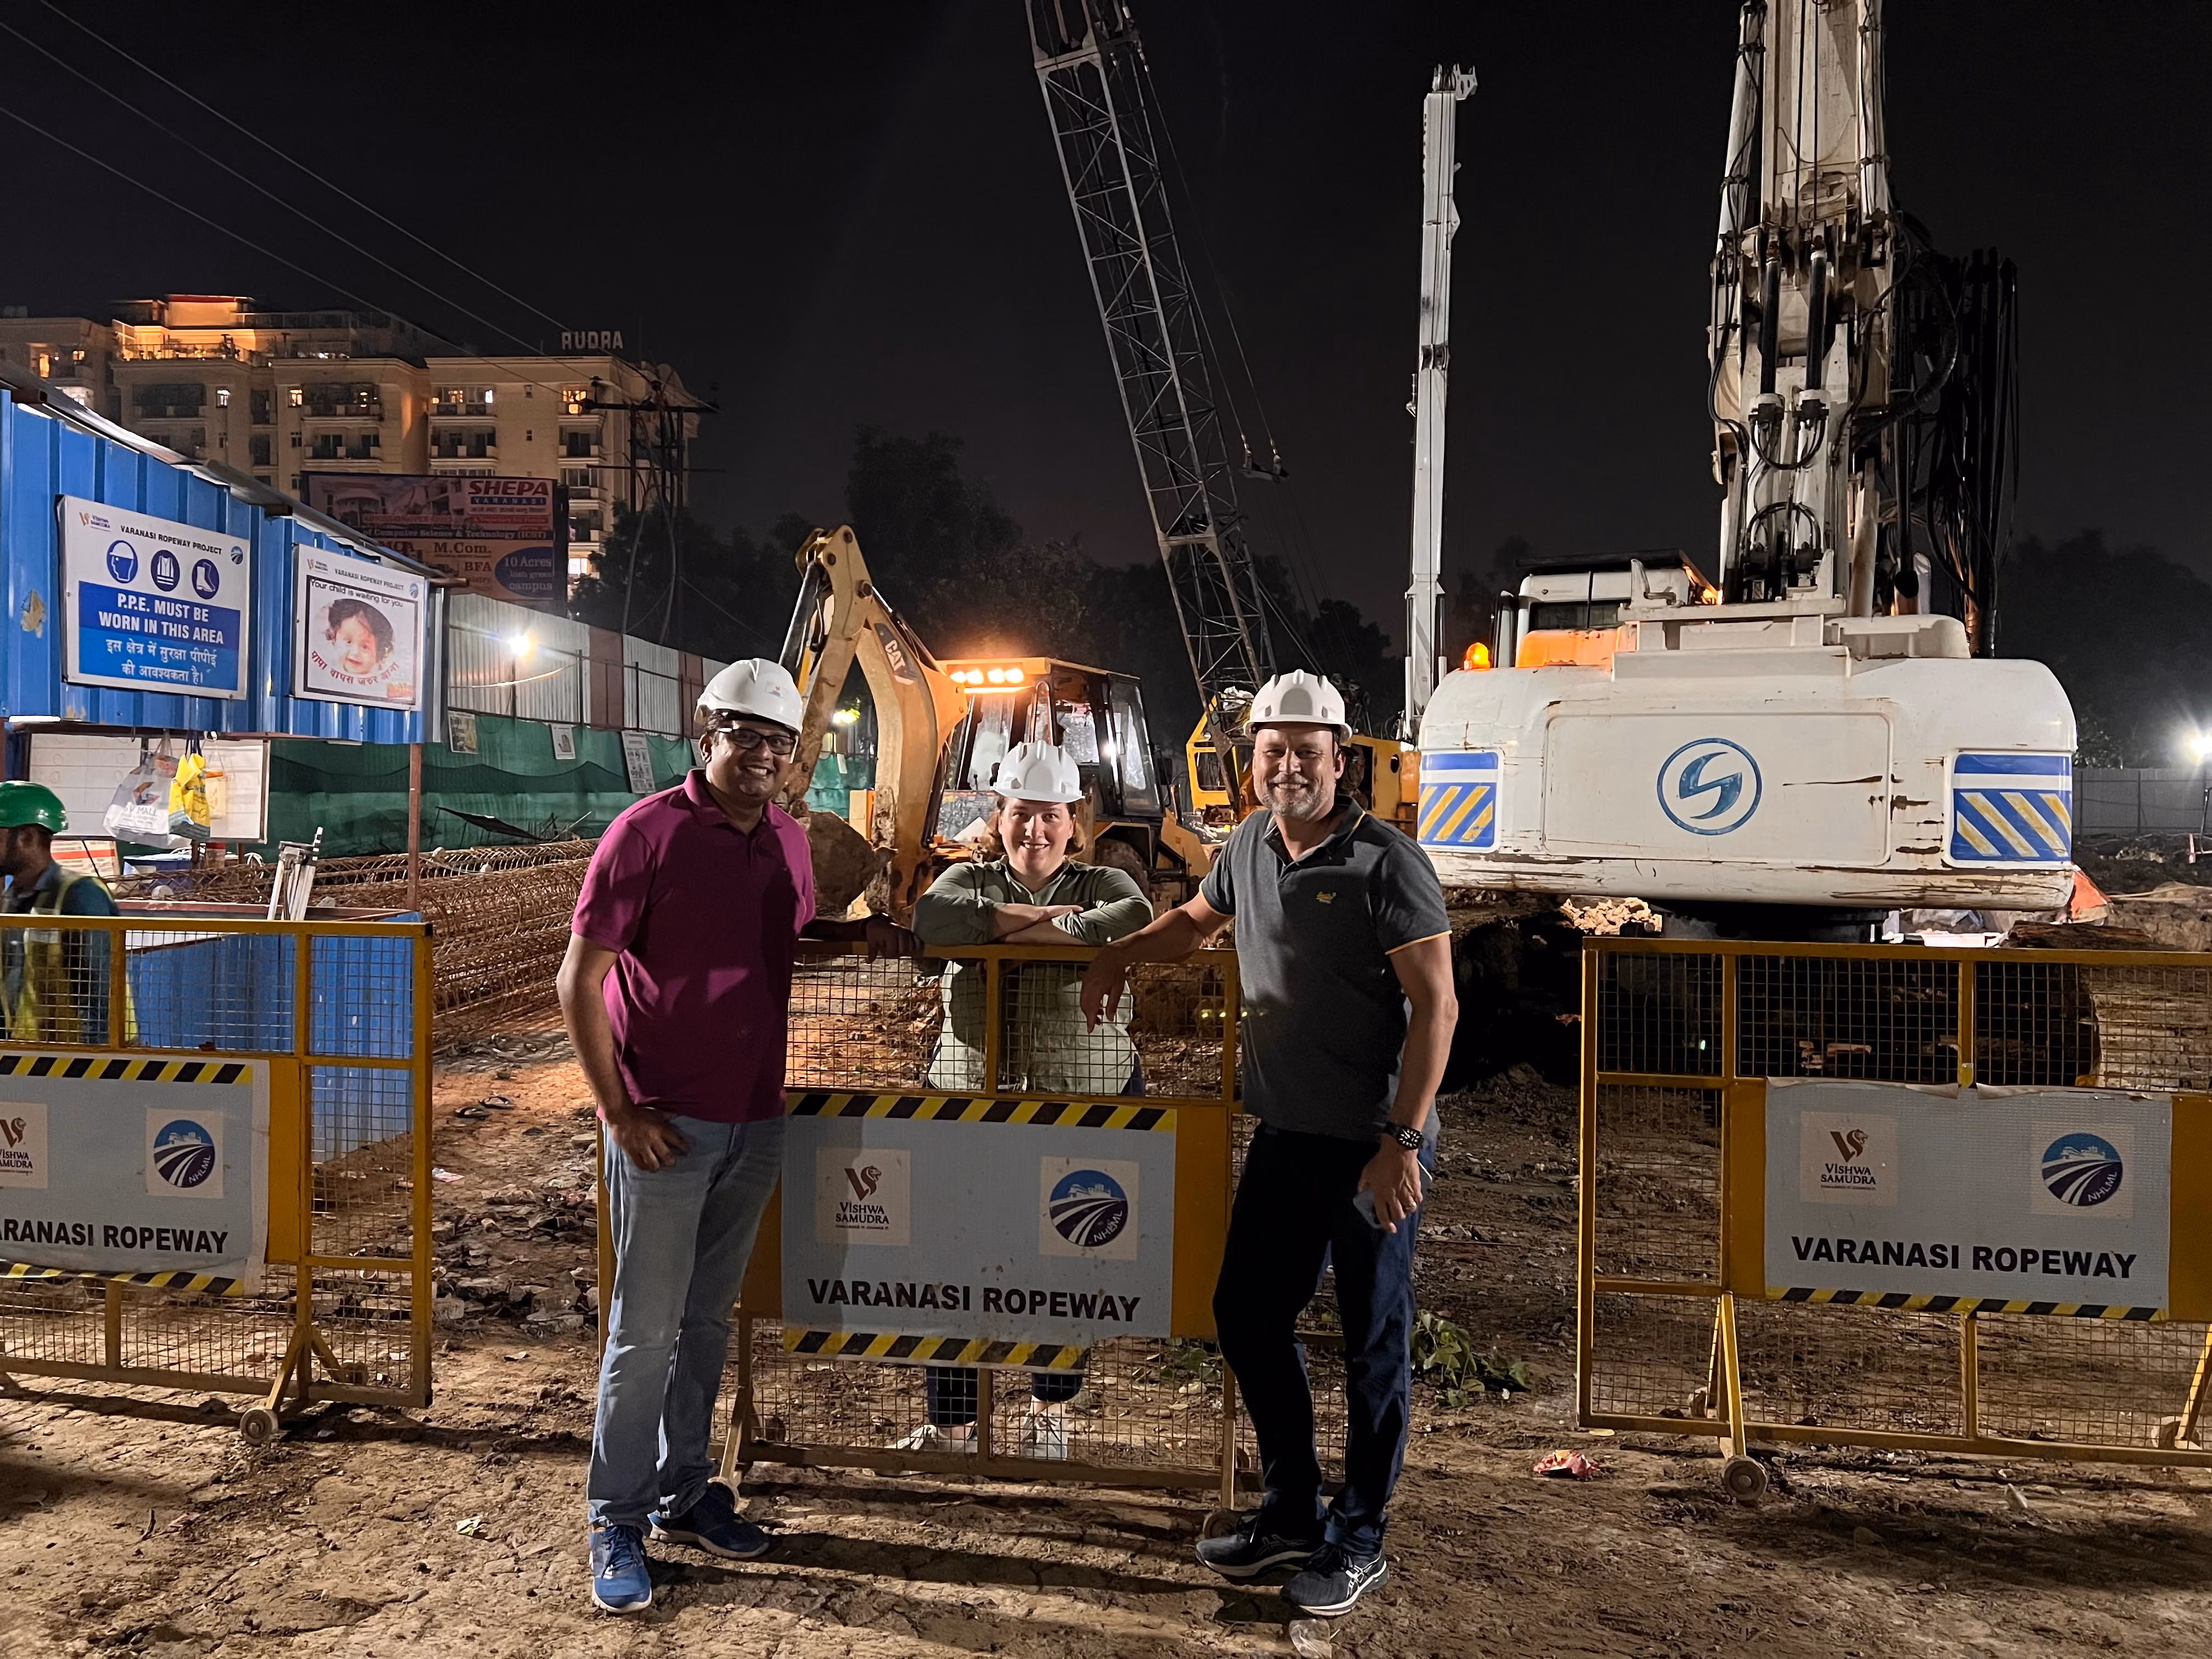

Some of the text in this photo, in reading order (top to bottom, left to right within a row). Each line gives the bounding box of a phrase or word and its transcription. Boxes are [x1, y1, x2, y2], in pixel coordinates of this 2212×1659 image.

[562, 330, 623, 350] RUDRA
[468, 480, 549, 495] SHEPA
[121, 525, 156, 539] VARANASI
[158, 534, 190, 548] ROPEWAY
[193, 542, 222, 555] PROJECT
[374, 529, 417, 538] Computer
[466, 530, 515, 539] Technology
[433, 542, 491, 554] M.Com.
[465, 562, 493, 571] BFA
[505, 556, 552, 567] 10 Acres
[311, 579, 328, 589] Your
[329, 584, 346, 594] child
[356, 592, 380, 603] waiting
[335, 568, 359, 579] VARANASI
[360, 575, 382, 585] ROPEWAY
[383, 580, 404, 591] PROJECT
[509, 583, 553, 592] campus
[117, 592, 208, 622] P.P.E. MUST BE
[99, 611, 224, 645] WORN IN THIS AREA
[106, 638, 217, 667] इस क्षेत्र में सुरक्षा पीपीई
[884, 640, 906, 671] CAT
[121, 659, 136, 676] की
[139, 665, 189, 682] आवश्यकता
[311, 651, 328, 670] पापा
[330, 668, 353, 684] वापस
[137, 806, 158, 816] MALL
[188, 1154, 211, 1184] NHLML
[1821, 1174, 1876, 1185] SAMUDRA
[1825, 1163, 1871, 1175] VISHWA
[2087, 1171, 2117, 1202] NHLML
[836, 1213, 889, 1224] SAMUDRA
[839, 1201, 884, 1214] VISHWA
[0, 1218, 229, 1254] RANASI ROPEWAY
[1093, 1211, 1122, 1242] NHLML
[1792, 1237, 2137, 1278] VARANASI ROPEWAY
[807, 1278, 1141, 1322] VARANASI ROPEWAY
